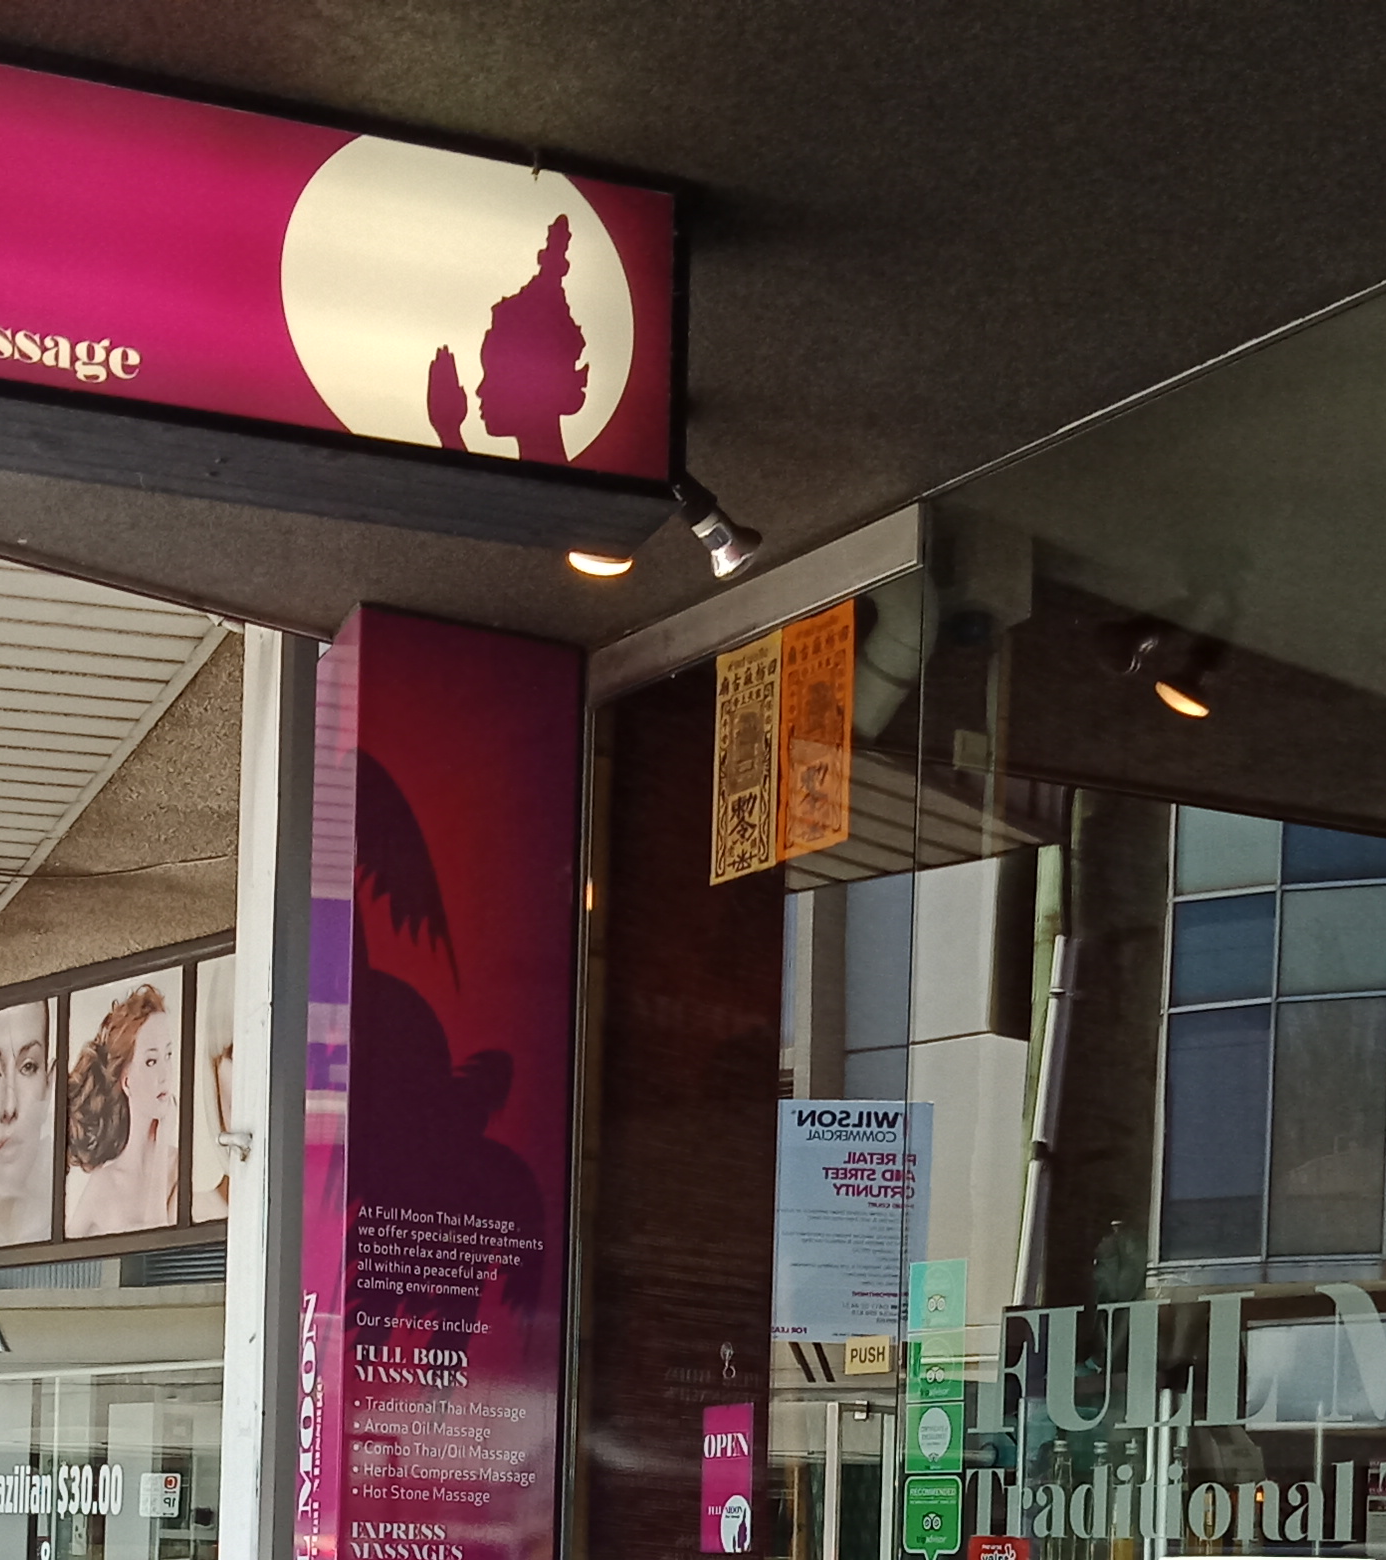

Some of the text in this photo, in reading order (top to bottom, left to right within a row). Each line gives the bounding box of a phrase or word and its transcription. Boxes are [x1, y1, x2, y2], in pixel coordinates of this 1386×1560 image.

[358, 1206, 372, 1218] At
[375, 1206, 398, 1220] Full
[400, 1208, 434, 1223] Moon
[436, 1211, 461, 1226] Thai
[358, 1225, 543, 1250] we offer specialised treatments
[358, 1242, 370, 1253] to
[373, 1241, 401, 1255] both
[403, 1245, 433, 1259] relax
[436, 1248, 456, 1260] and
[357, 1259, 497, 1281] all within a peaceful and
[357, 1277, 403, 1295] calming
[356, 1311, 381, 1326] Our
[384, 1315, 439, 1331] services
[356, 1344, 469, 1367] FULL BODY
[850, 1346, 886, 1364] PUSH
[967, 1290, 1278, 1433] FULL
[354, 1365, 468, 1390] MASSAGES
[298, 1290, 317, 1521] MOON
[704, 1433, 748, 1458] OPEN
[57, 1461, 123, 1519] $30.00
[363, 1484, 490, 1507] Hot Stone Massage
[966, 1460, 1356, 1543] Traditional
[351, 1521, 447, 1541] EXPRESS
